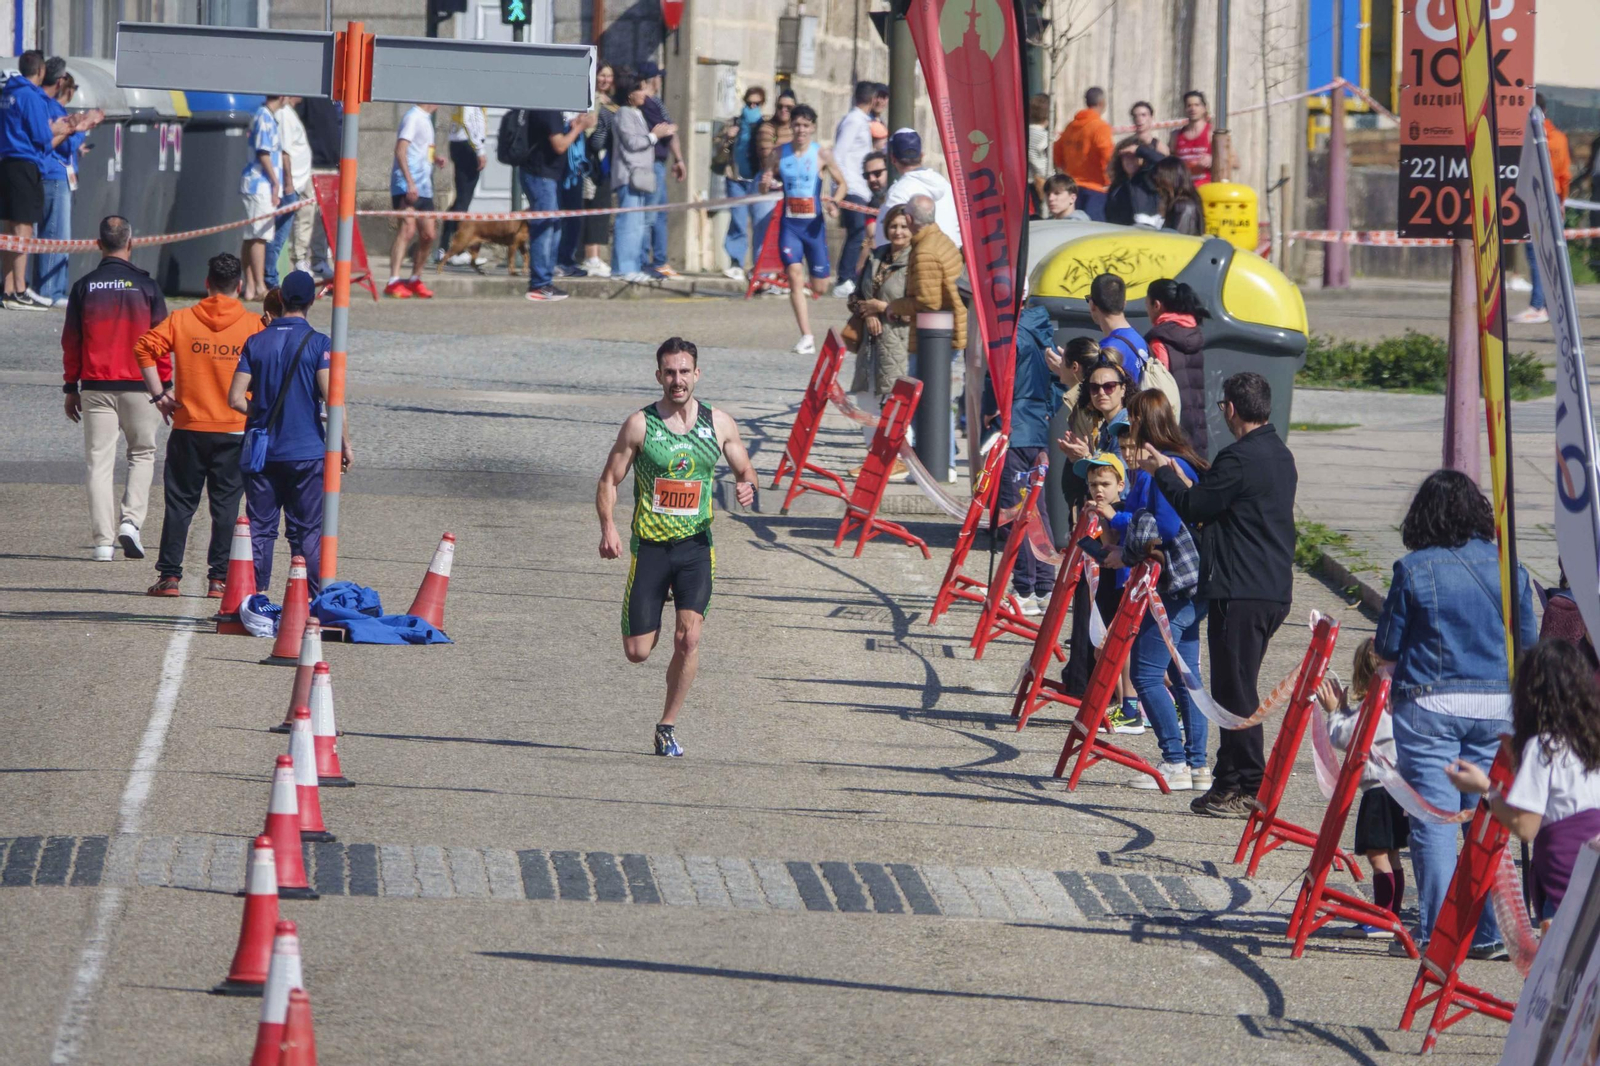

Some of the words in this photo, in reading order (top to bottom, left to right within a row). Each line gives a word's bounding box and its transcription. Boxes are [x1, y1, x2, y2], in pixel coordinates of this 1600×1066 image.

[1448, 157, 1519, 179] Mzo
[1222, 219, 1250, 227] PILAS
[660, 491, 695, 508] 2002
